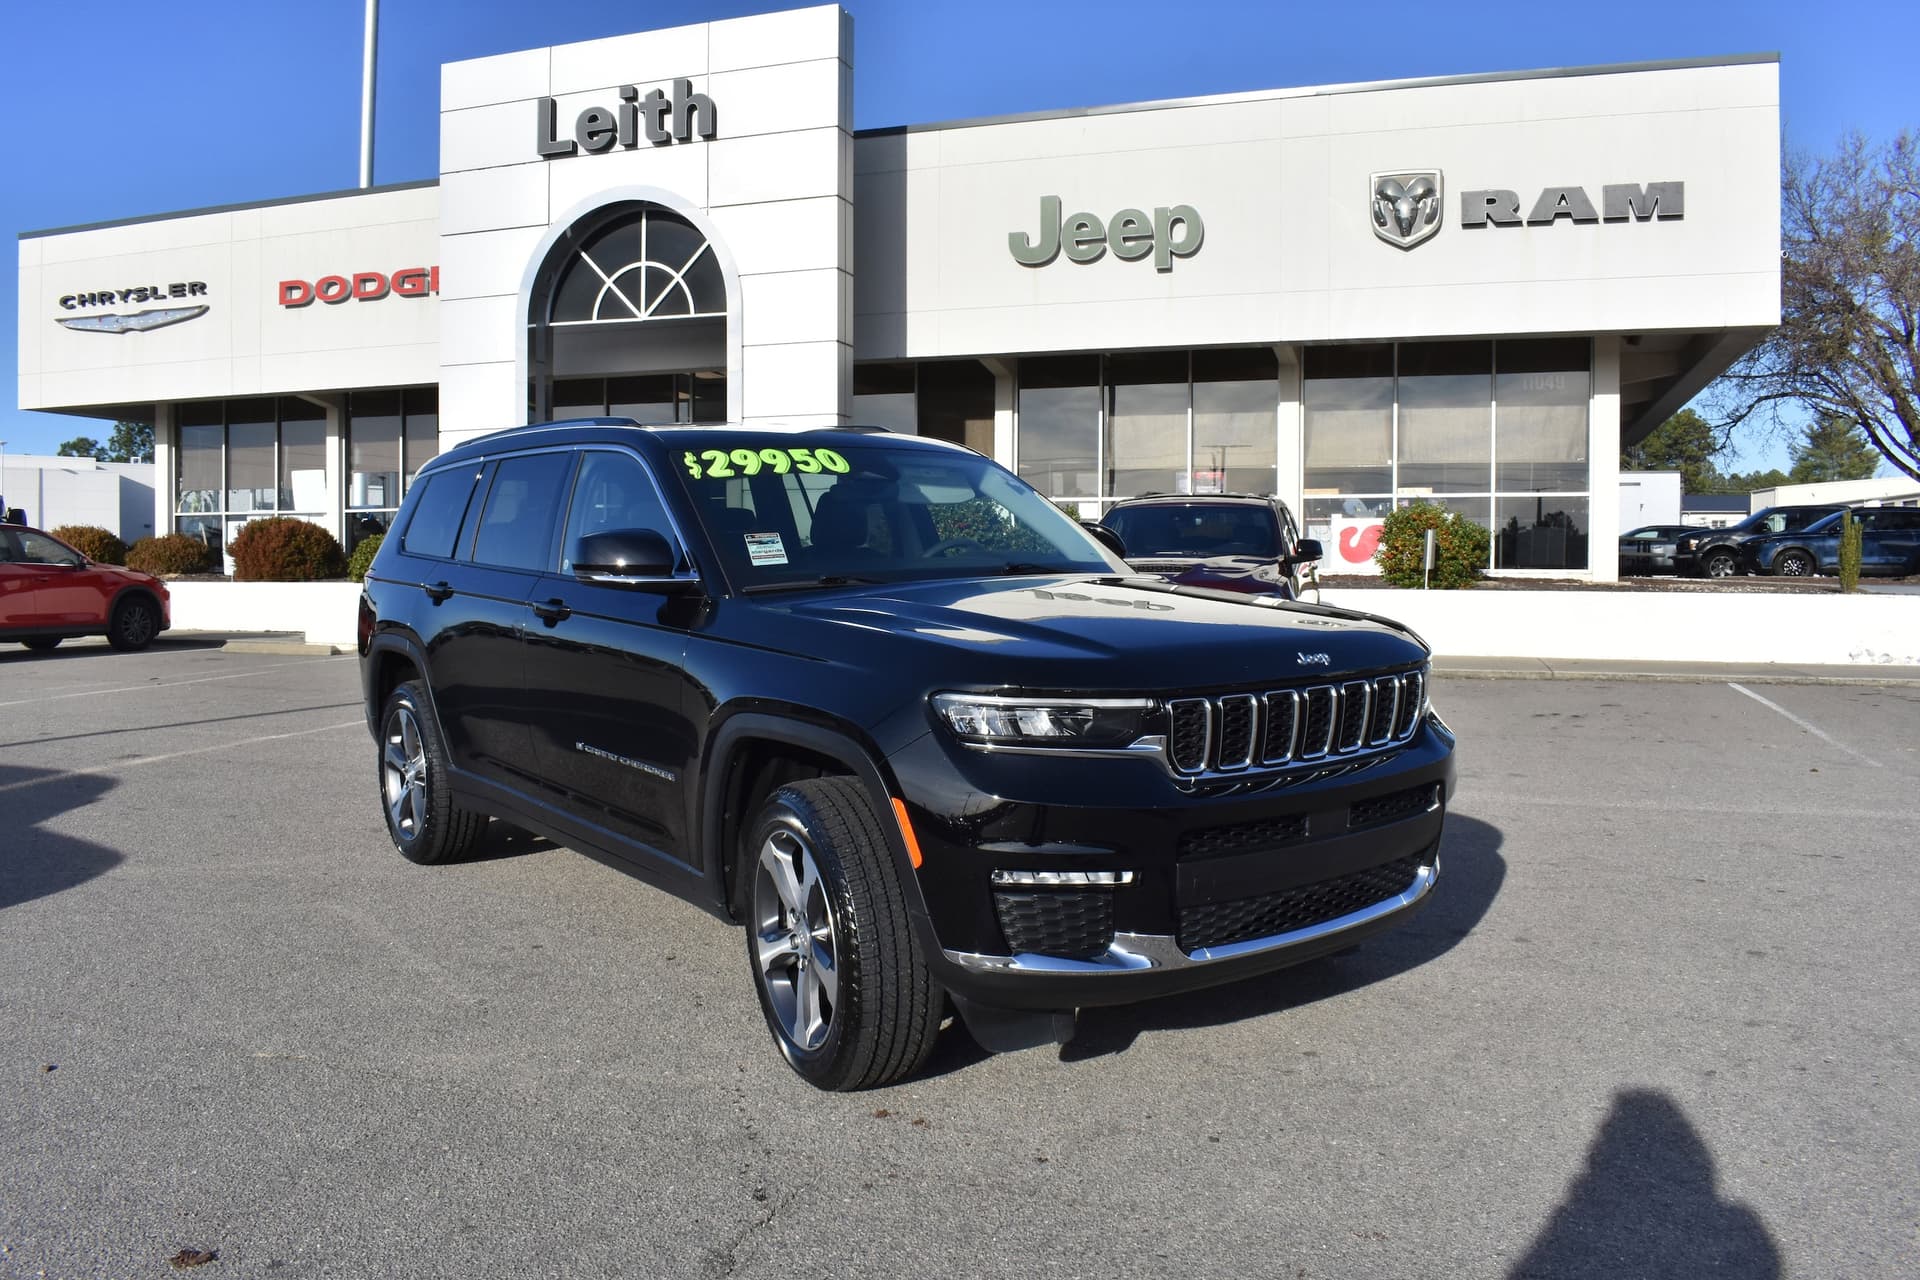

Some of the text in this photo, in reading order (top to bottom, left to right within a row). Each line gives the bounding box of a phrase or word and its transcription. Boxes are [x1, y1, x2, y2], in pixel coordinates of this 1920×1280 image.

[537, 79, 717, 161] Leith
[1461, 181, 1685, 229] RAM
[1008, 195, 1205, 273] Jeep
[59, 281, 208, 310] CHRYSLER
[684, 449, 850, 480] $29950
[1296, 651, 1331, 666] Jeep
